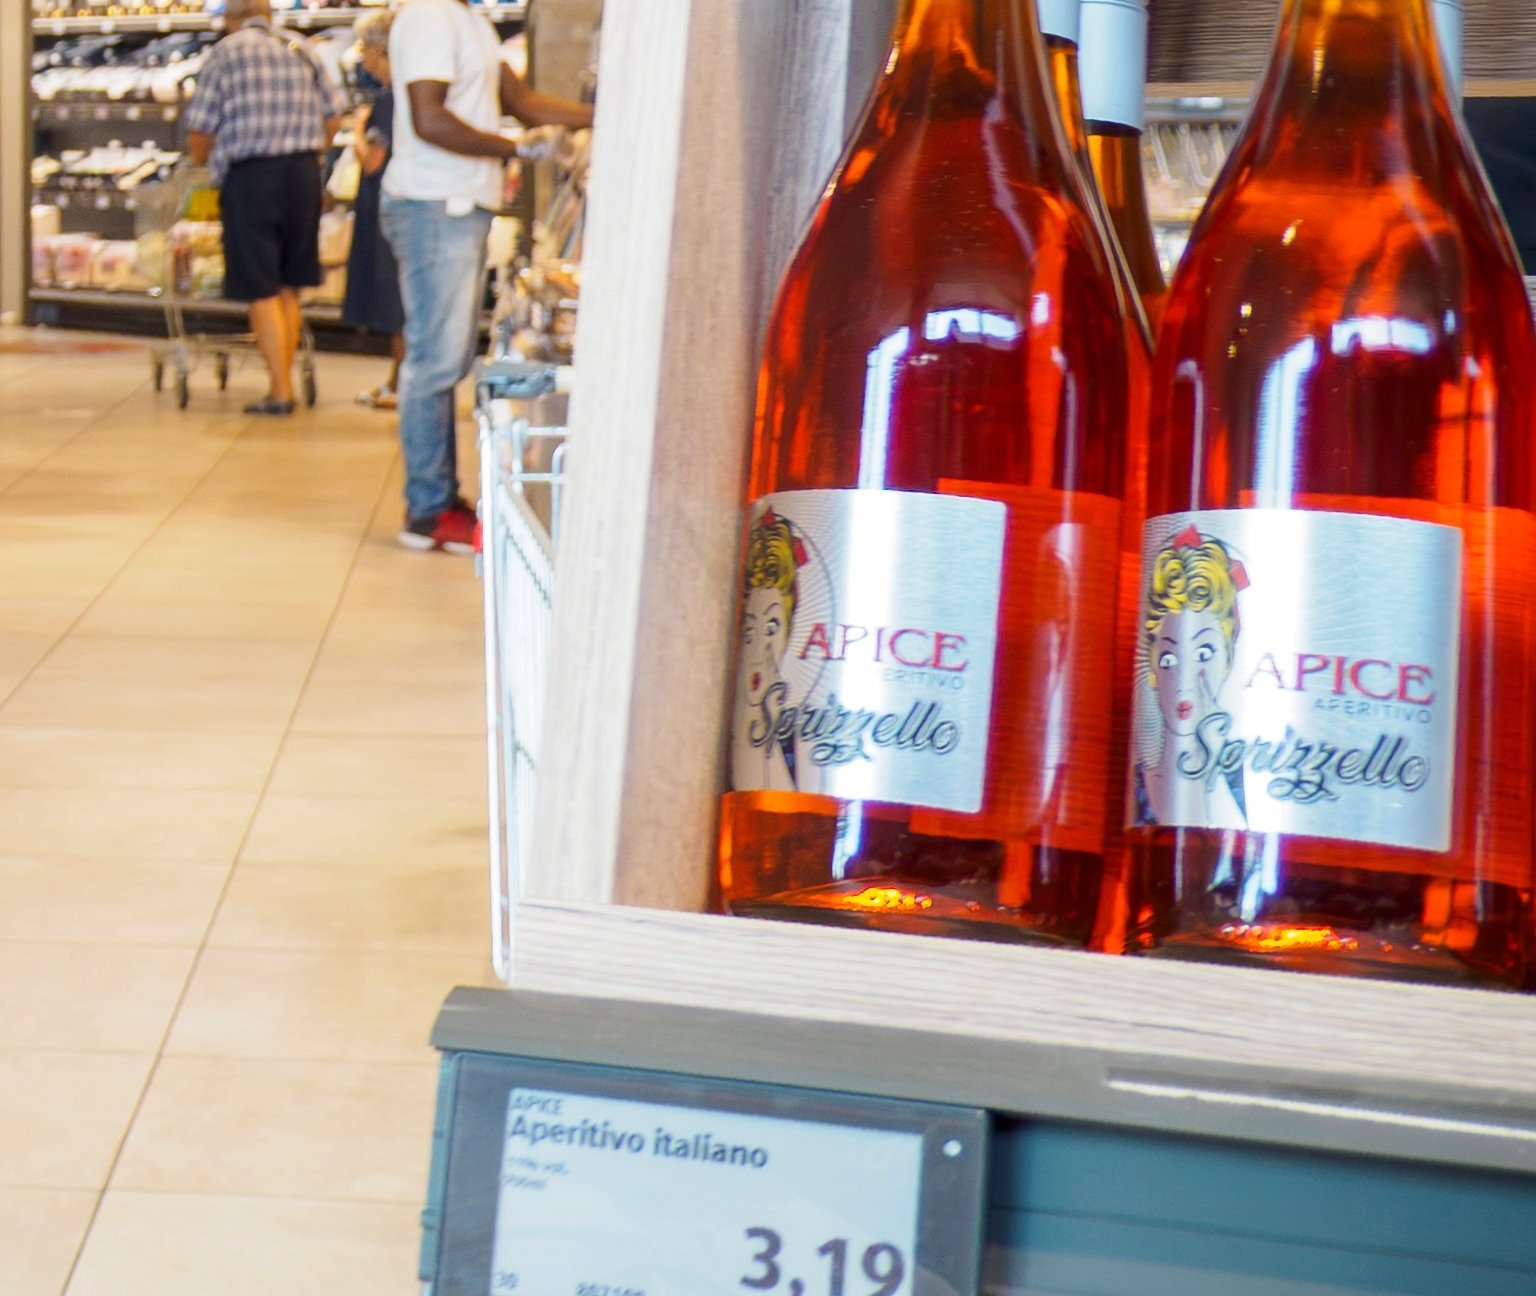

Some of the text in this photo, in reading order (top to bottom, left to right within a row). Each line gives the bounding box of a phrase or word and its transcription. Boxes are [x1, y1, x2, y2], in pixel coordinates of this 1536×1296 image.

[797, 621, 970, 672] APICE
[1245, 652, 1437, 705] APICE
[750, 680, 959, 766] Sprizzello
[1313, 697, 1432, 724] APERITIVO
[1177, 711, 1428, 804] Sprizzello
[509, 1115, 769, 1168] Aperitivo italiano
[739, 1227, 906, 1296] 3,19
